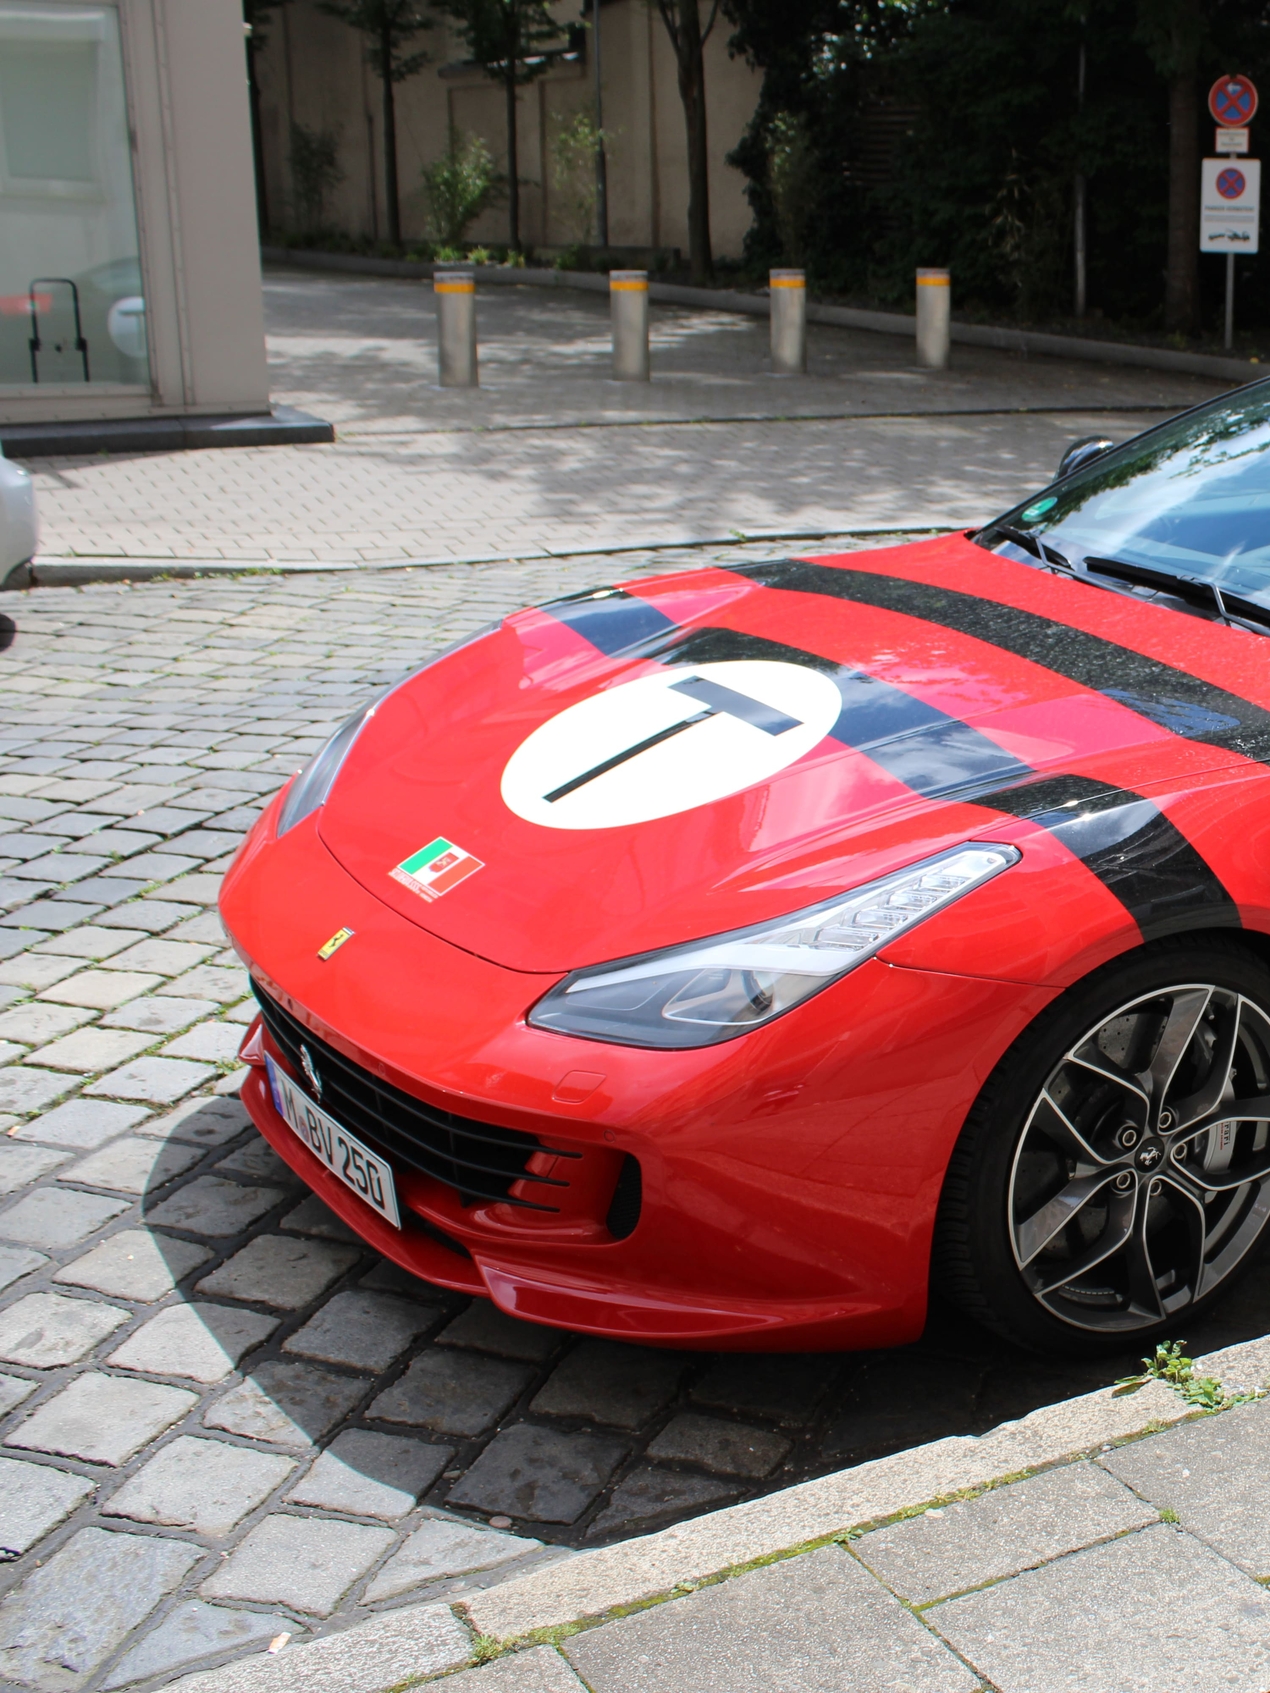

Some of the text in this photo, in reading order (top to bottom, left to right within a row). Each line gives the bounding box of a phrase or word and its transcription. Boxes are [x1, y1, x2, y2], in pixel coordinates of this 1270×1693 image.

[542, 675, 805, 804] T
[281, 1079, 386, 1210] M BV 250
